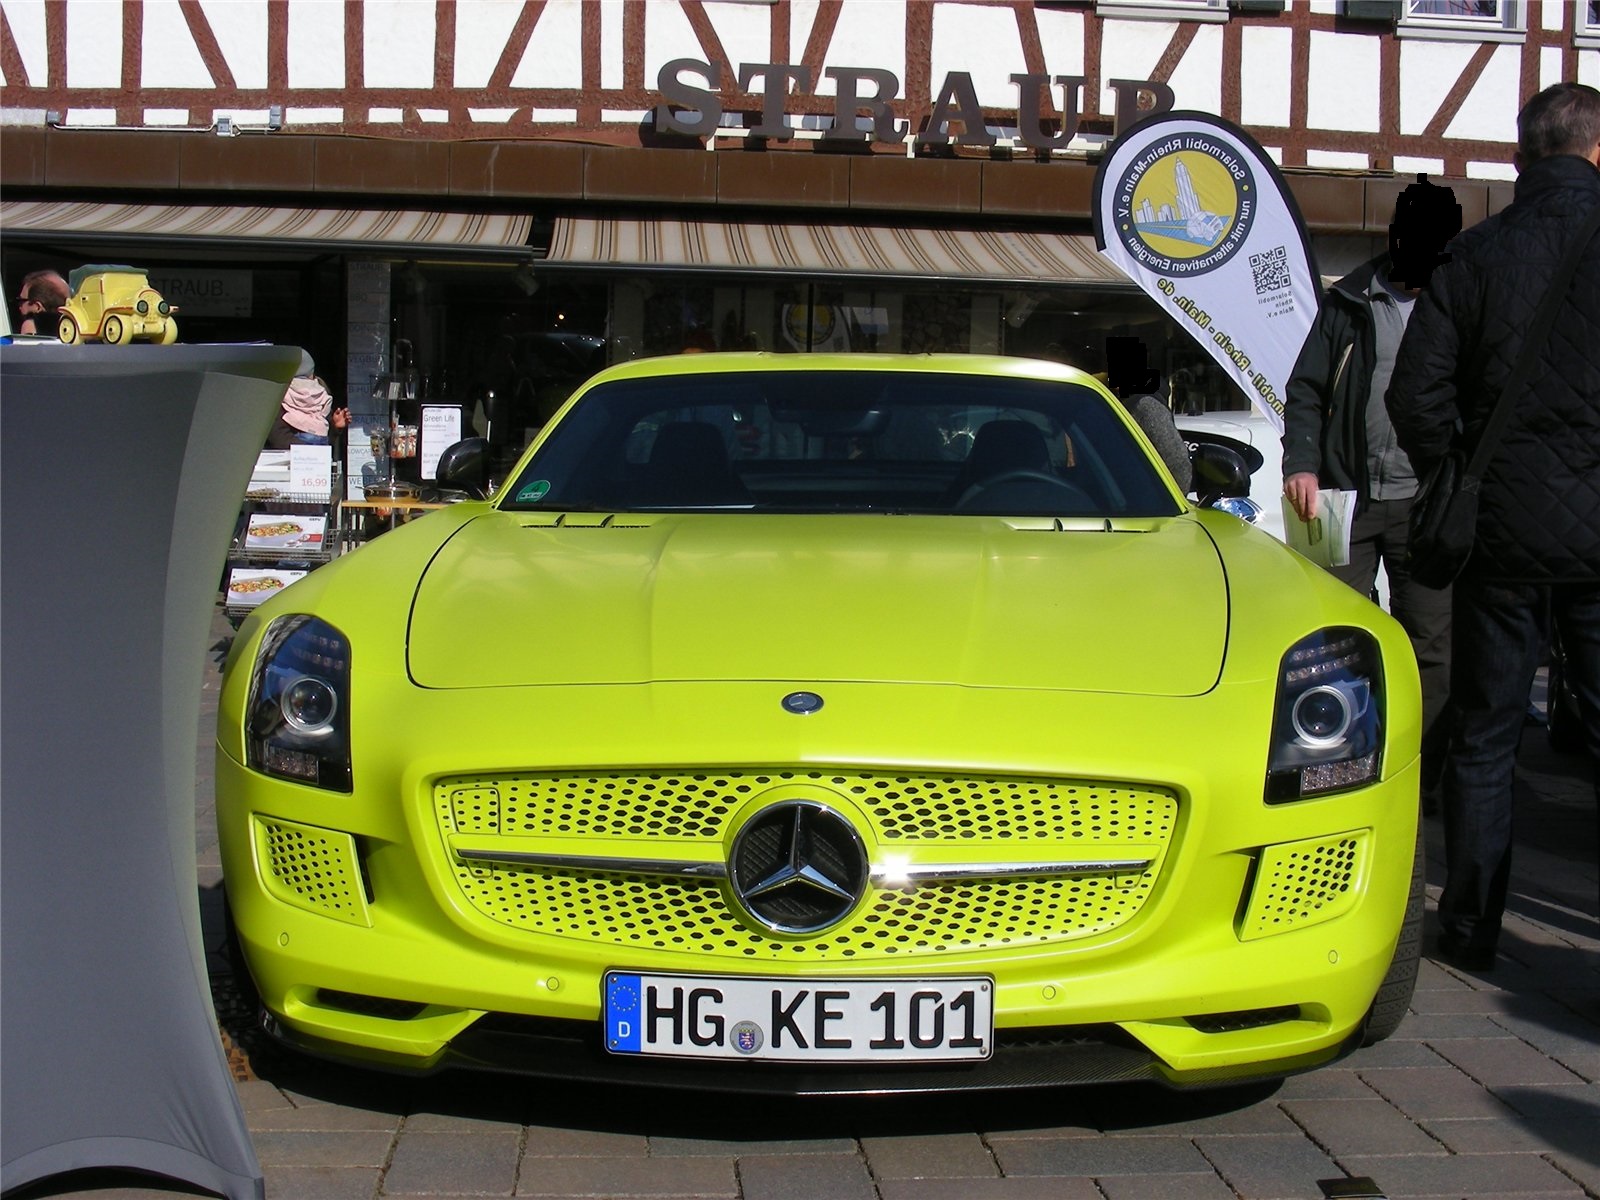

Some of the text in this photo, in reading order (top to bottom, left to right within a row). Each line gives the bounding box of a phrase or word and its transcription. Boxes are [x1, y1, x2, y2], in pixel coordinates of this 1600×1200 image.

[423, 414, 443, 423] Green
[302, 478, 327, 488] 16,99
[646, 985, 984, 1050] HG KE 101
[618, 1021, 630, 1038] D
